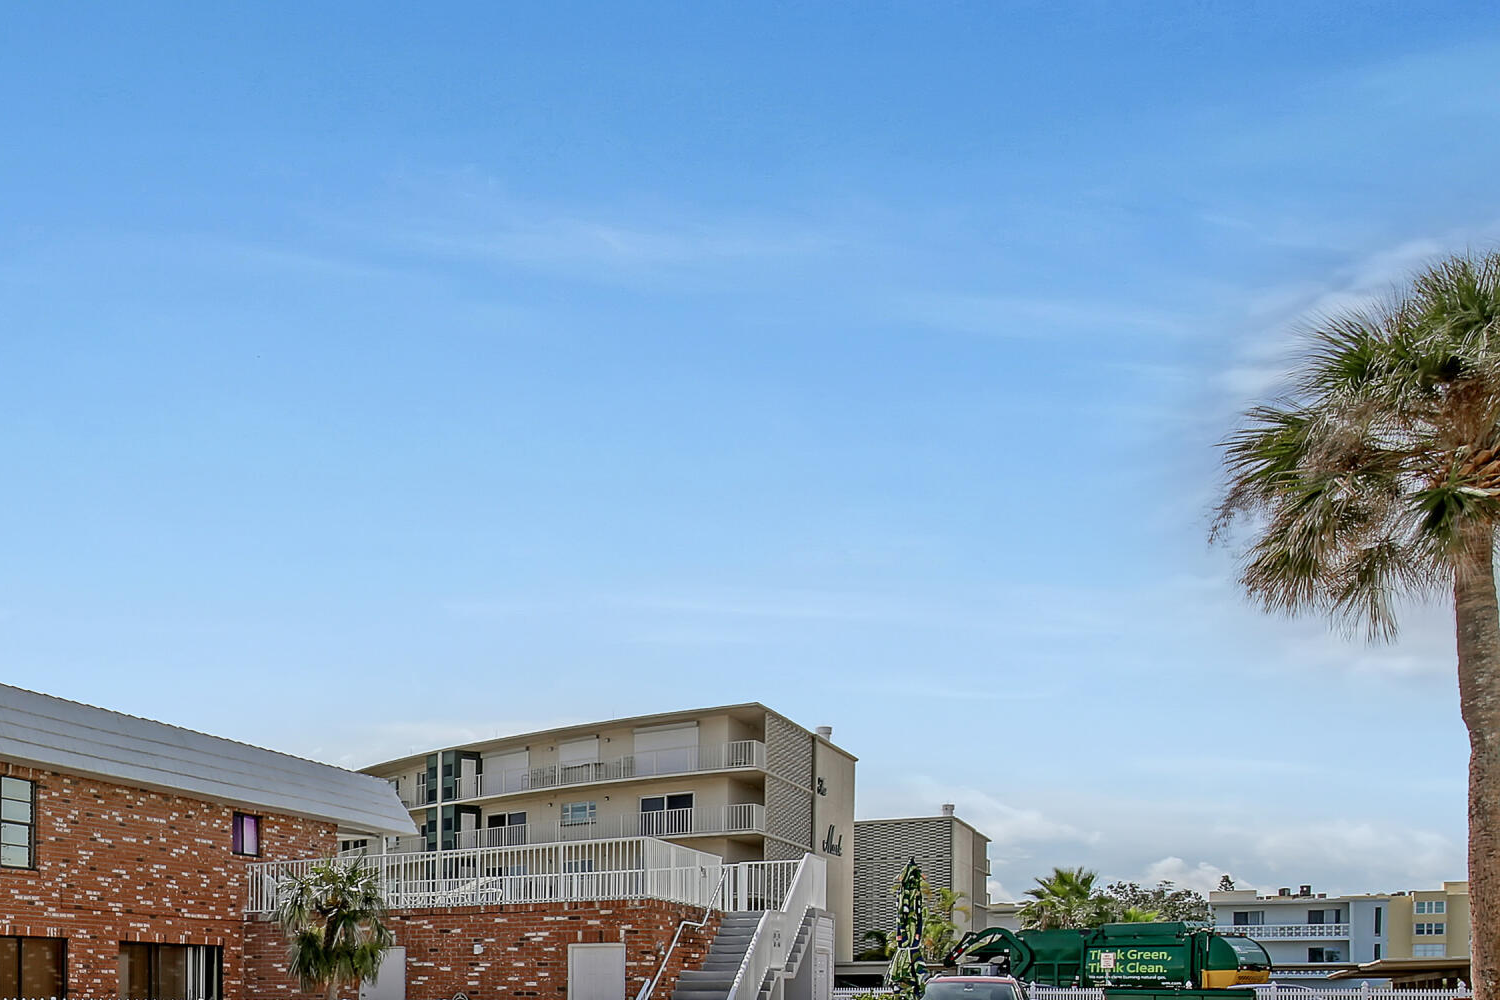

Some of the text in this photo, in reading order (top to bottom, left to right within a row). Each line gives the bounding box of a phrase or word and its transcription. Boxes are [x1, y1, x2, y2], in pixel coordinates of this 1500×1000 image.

[1089, 949, 1173, 961] Thk Green,
[1126, 962, 1168, 973] Clean.
